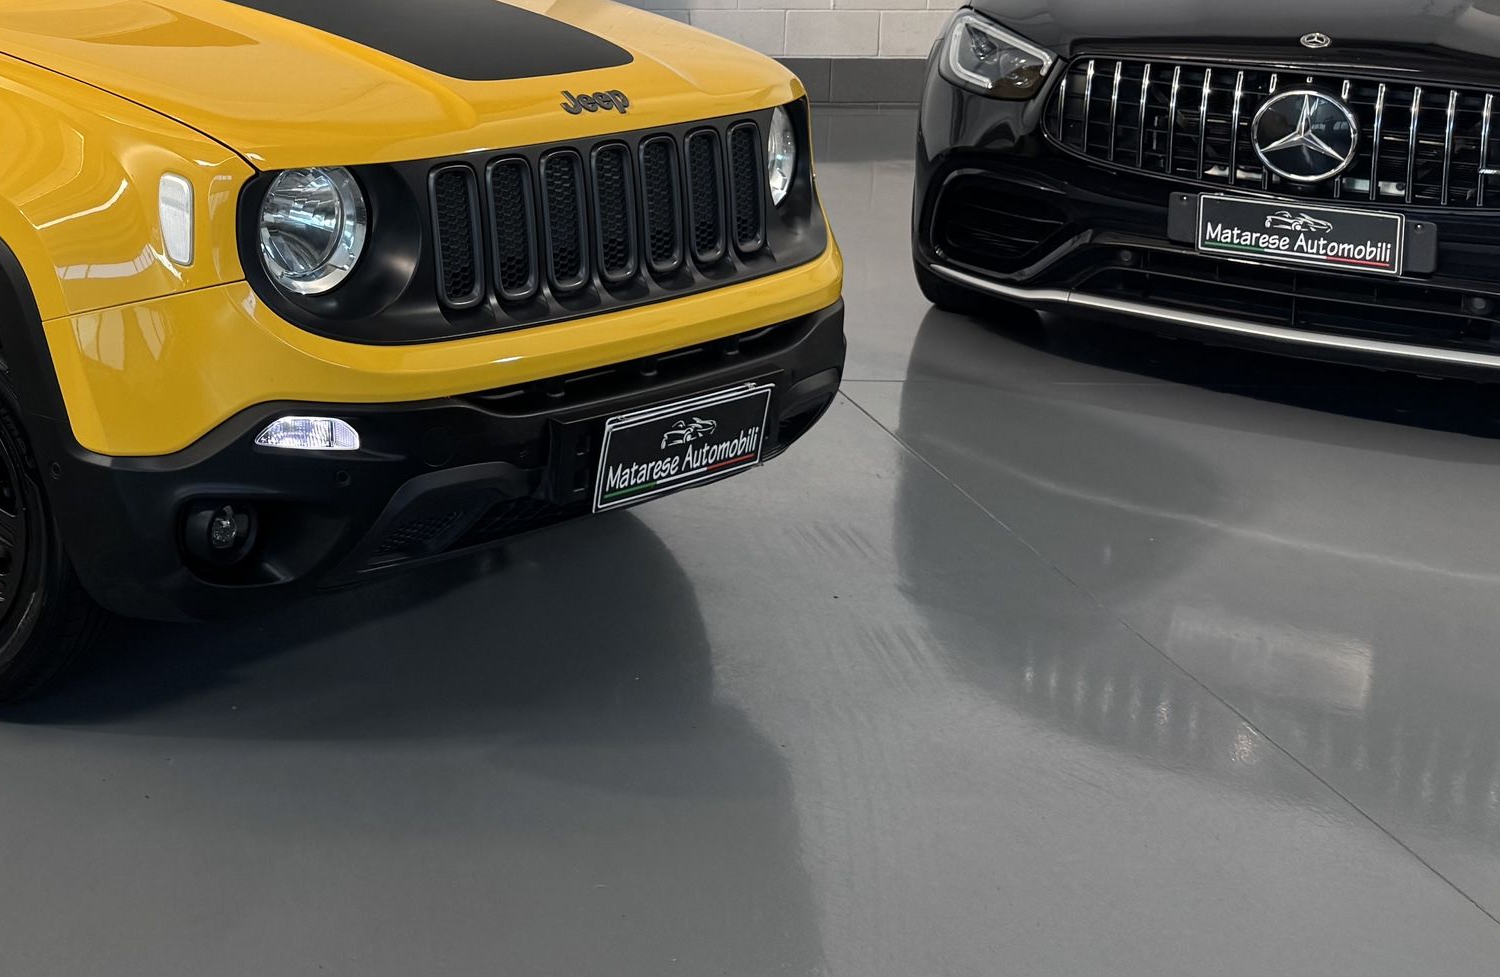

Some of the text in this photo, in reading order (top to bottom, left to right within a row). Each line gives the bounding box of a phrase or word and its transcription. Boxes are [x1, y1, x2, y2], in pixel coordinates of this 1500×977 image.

[560, 89, 629, 115] Jeep
[1206, 222, 1391, 263] Matarese Automobili
[607, 426, 759, 492] Matarese Automobili
